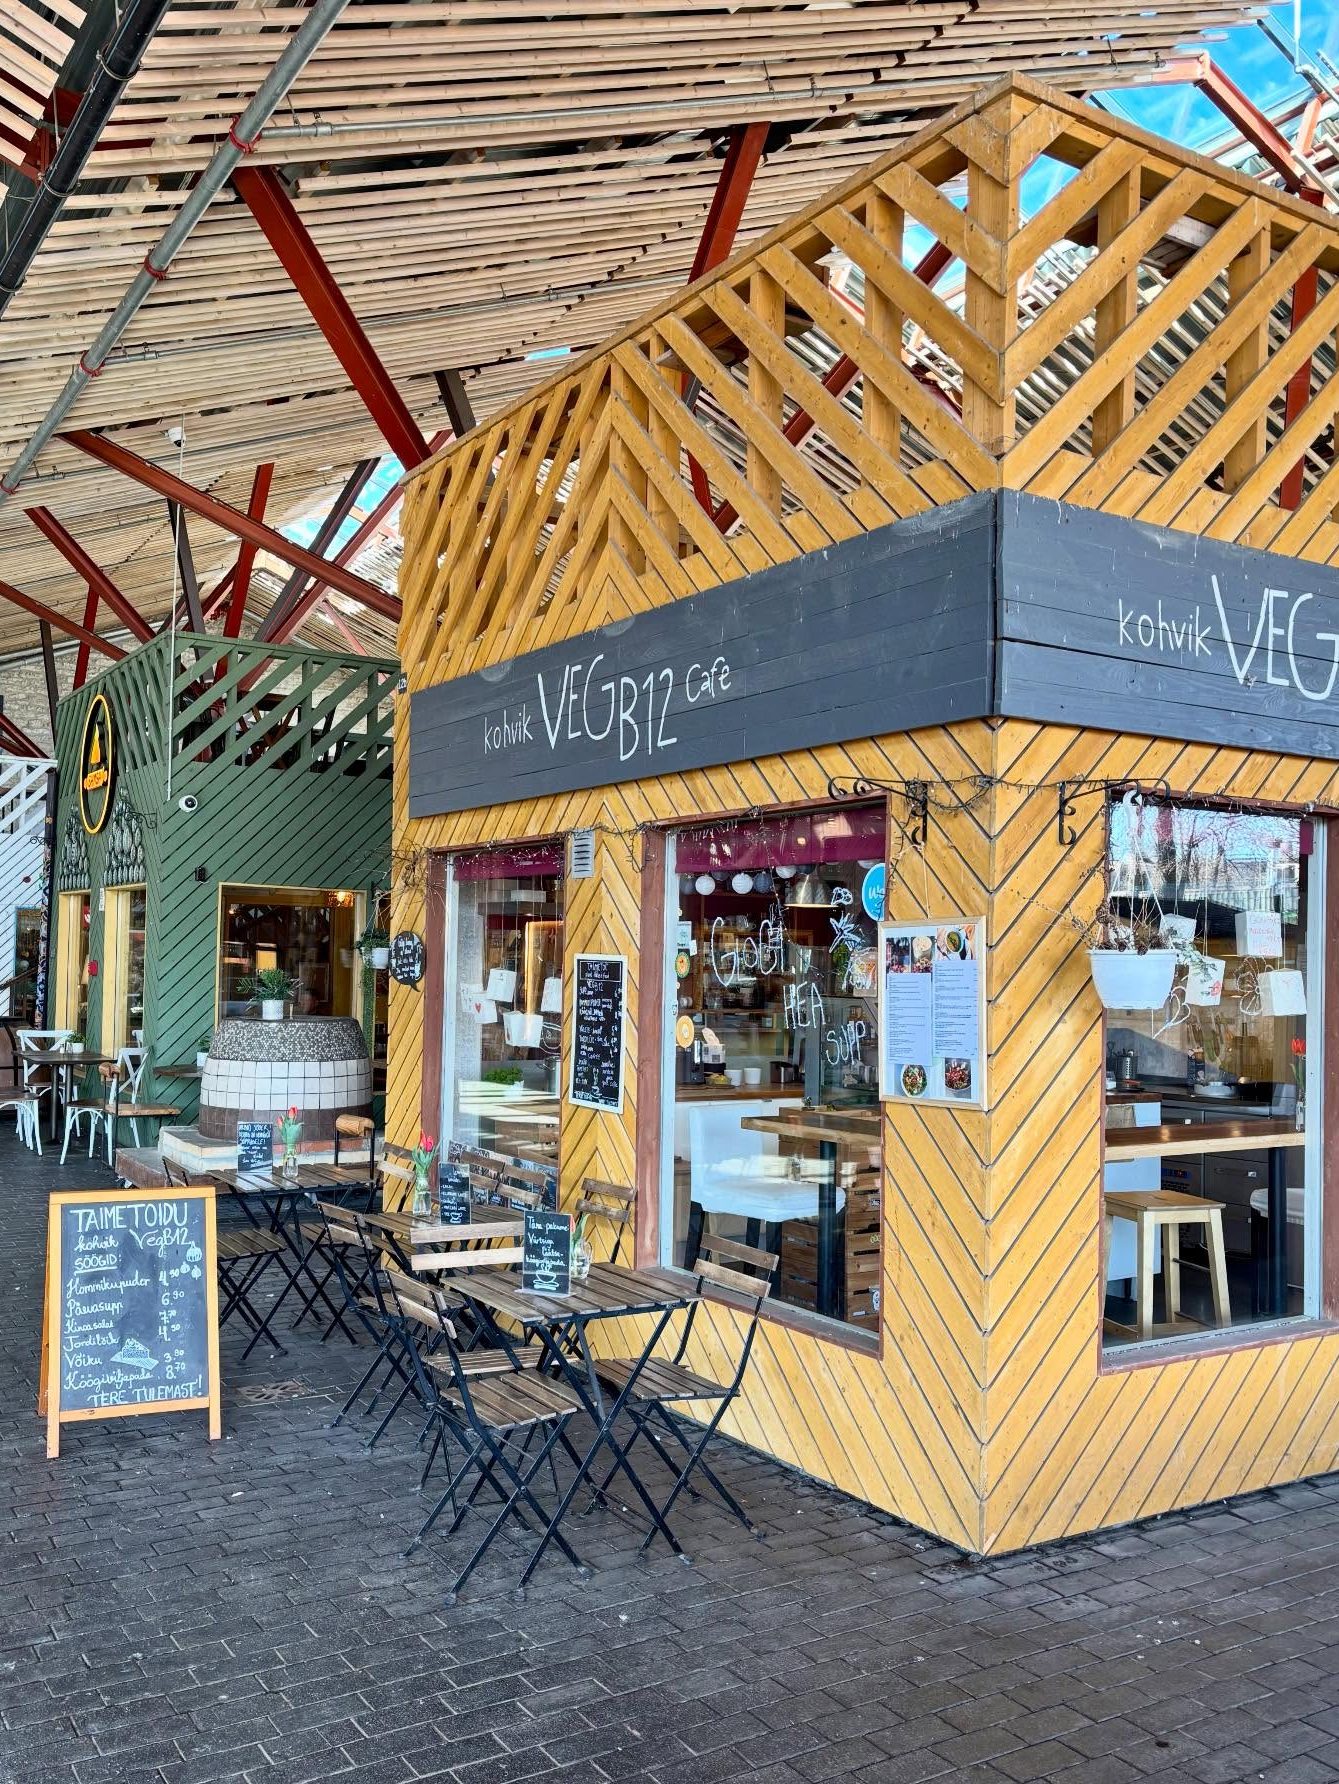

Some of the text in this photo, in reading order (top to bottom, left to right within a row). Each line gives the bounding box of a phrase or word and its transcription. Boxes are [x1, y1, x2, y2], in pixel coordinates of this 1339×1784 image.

[1118, 598, 1212, 657] kohvik
[484, 703, 533, 754] kohvik
[537, 654, 678, 762] VEGB12
[783, 981, 826, 1029] HEA
[826, 1020, 866, 1066] SUPP
[74, 1234, 119, 1252] kohvik
[66, 1269, 150, 1299] Hommikupuder
[65, 1299, 123, 1318] Päevasupp
[86, 1374, 203, 1408] TERE TULEMAST!
